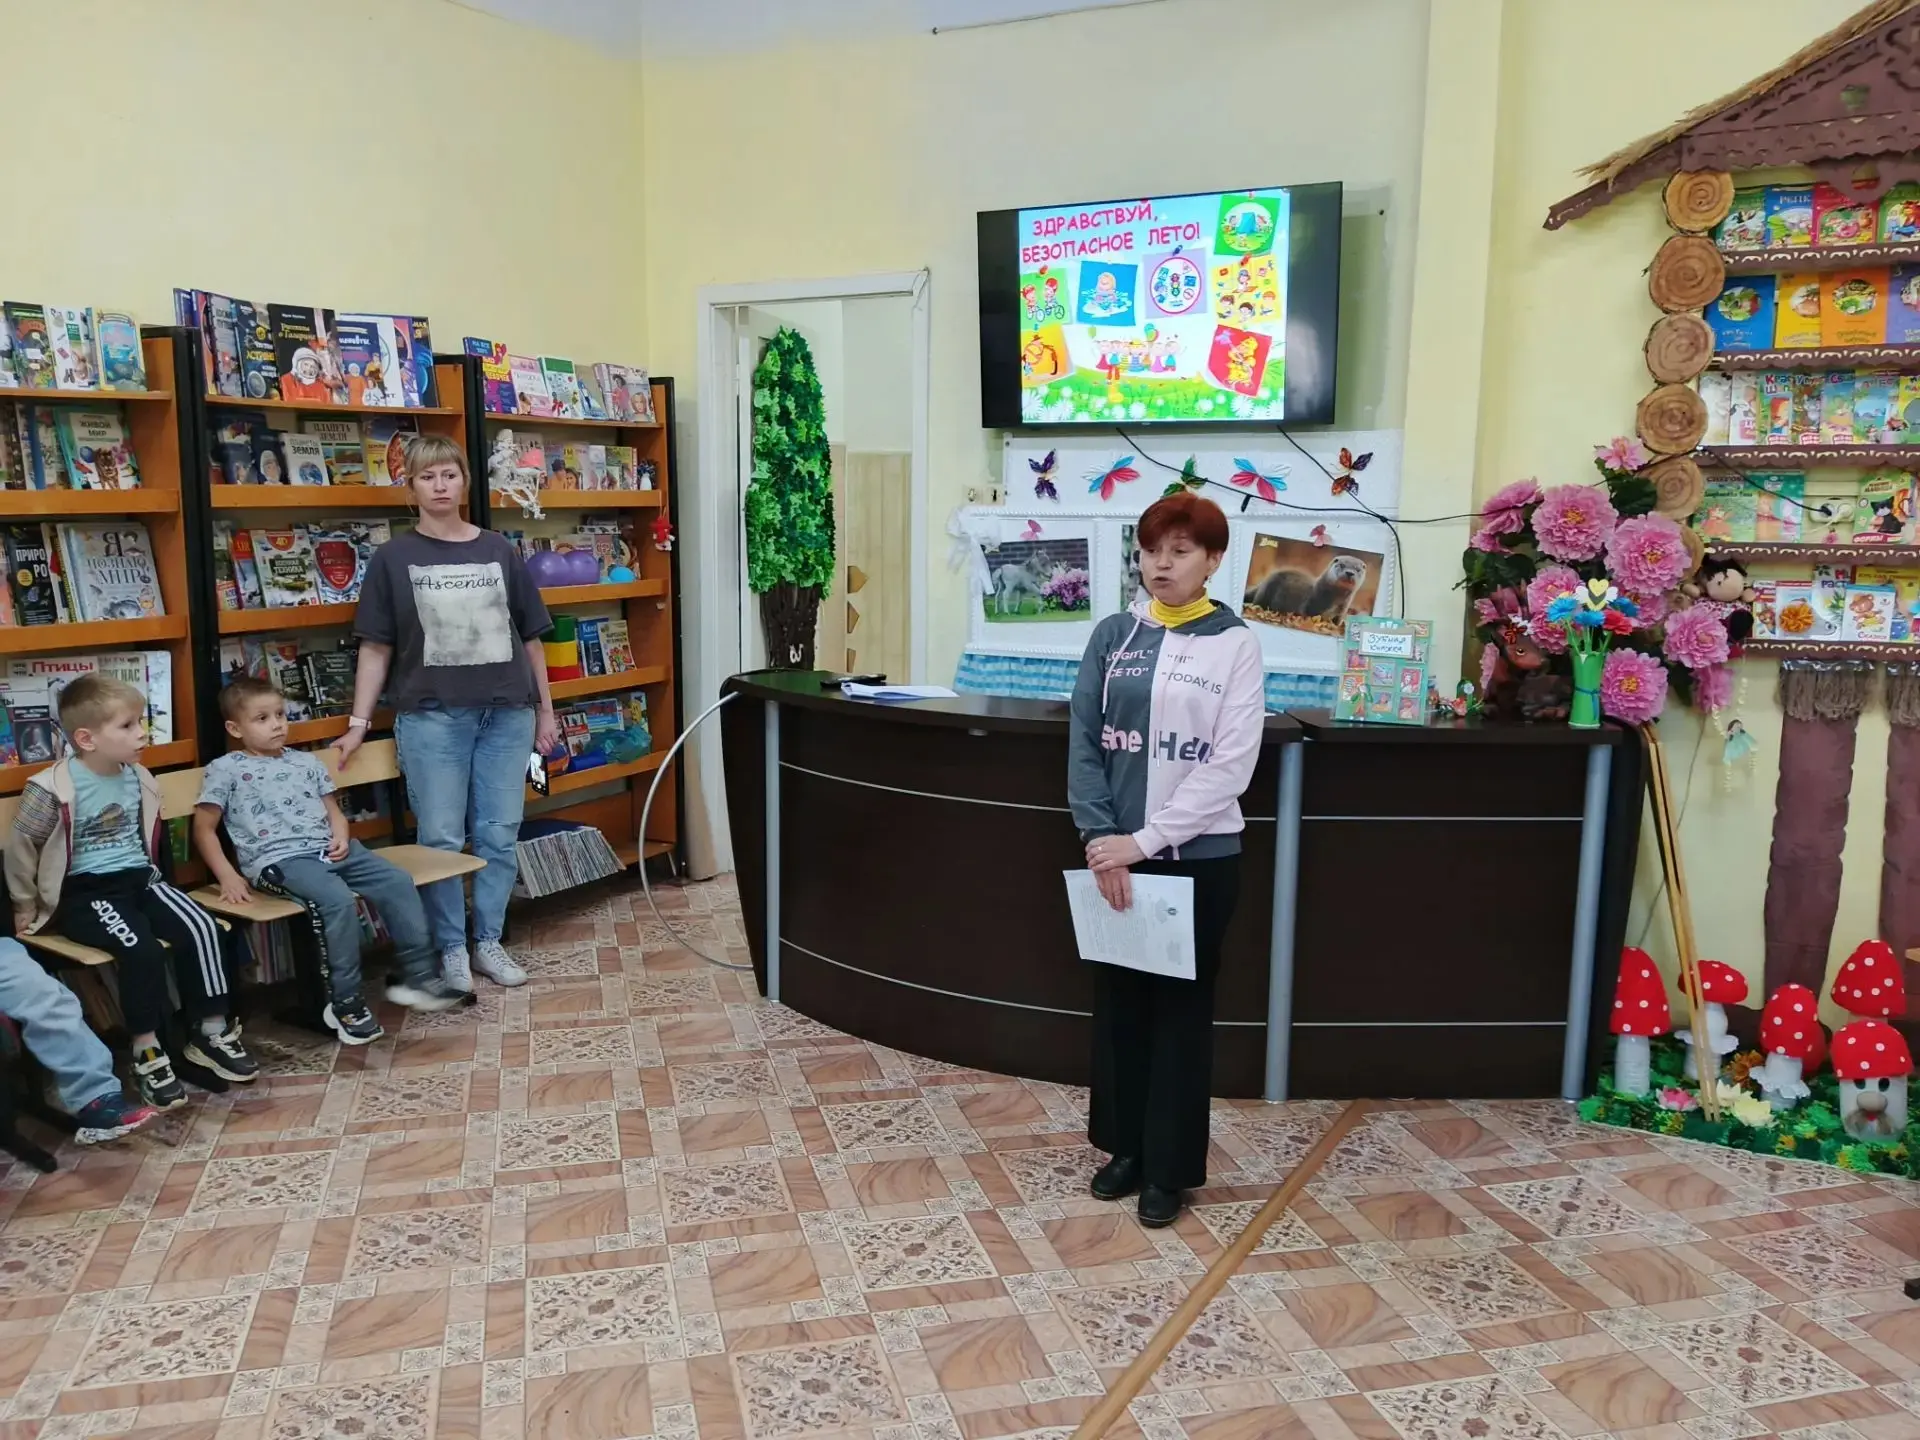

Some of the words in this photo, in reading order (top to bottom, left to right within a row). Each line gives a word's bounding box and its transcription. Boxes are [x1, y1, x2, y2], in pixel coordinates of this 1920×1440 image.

[1032, 203, 1158, 237] ЗДРАВСТВУЙ,
[1021, 231, 1134, 264] БЕЗОПАСНОЕ
[1148, 221, 1201, 247] ЛЕТО!
[102, 531, 123, 557] Я
[98, 569, 141, 585] МИР
[414, 573, 500, 590] Ascender
[1210, 683, 1222, 695] IS
[91, 900, 138, 947] adidas
